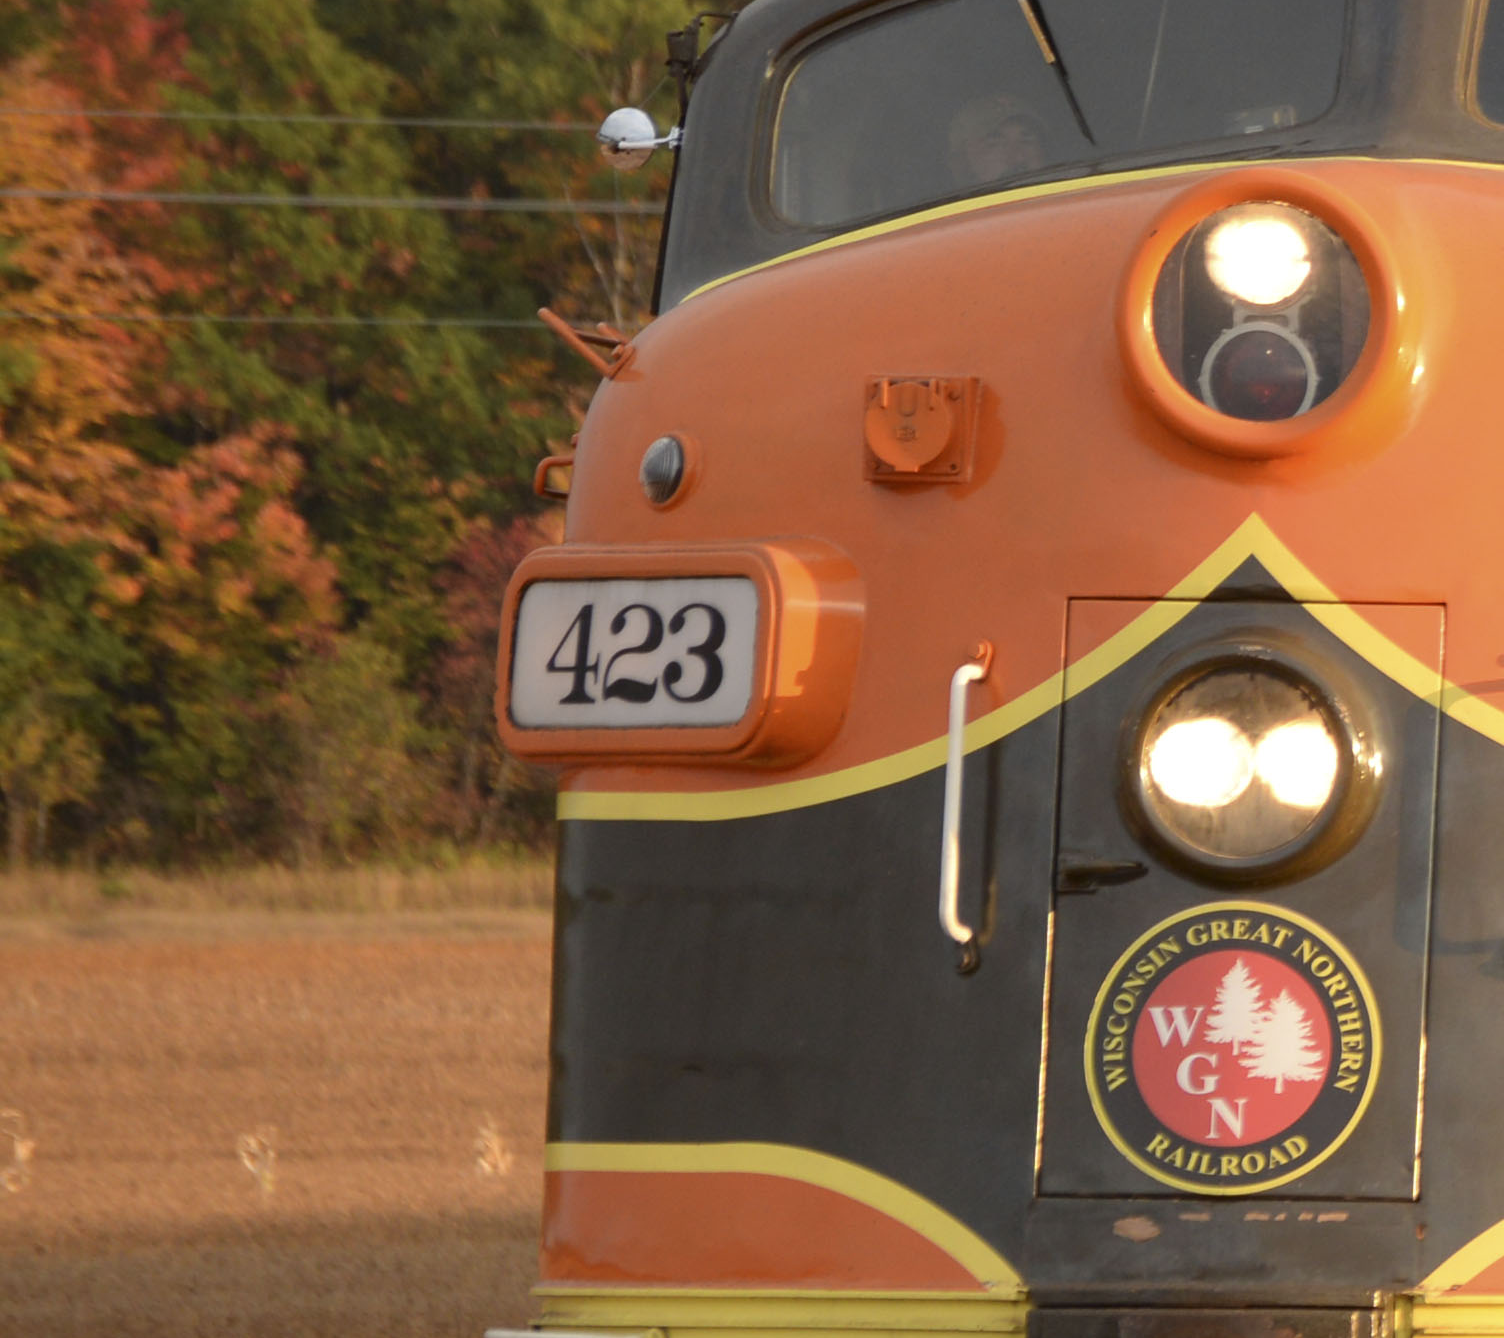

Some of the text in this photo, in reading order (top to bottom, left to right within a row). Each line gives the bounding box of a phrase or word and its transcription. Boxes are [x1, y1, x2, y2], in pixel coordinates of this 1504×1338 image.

[545, 599, 728, 706] 423
[1104, 918, 1369, 1094] WISCONSIN GREAT NORTHERN
[1145, 1133, 1310, 1177] RAILROAD
